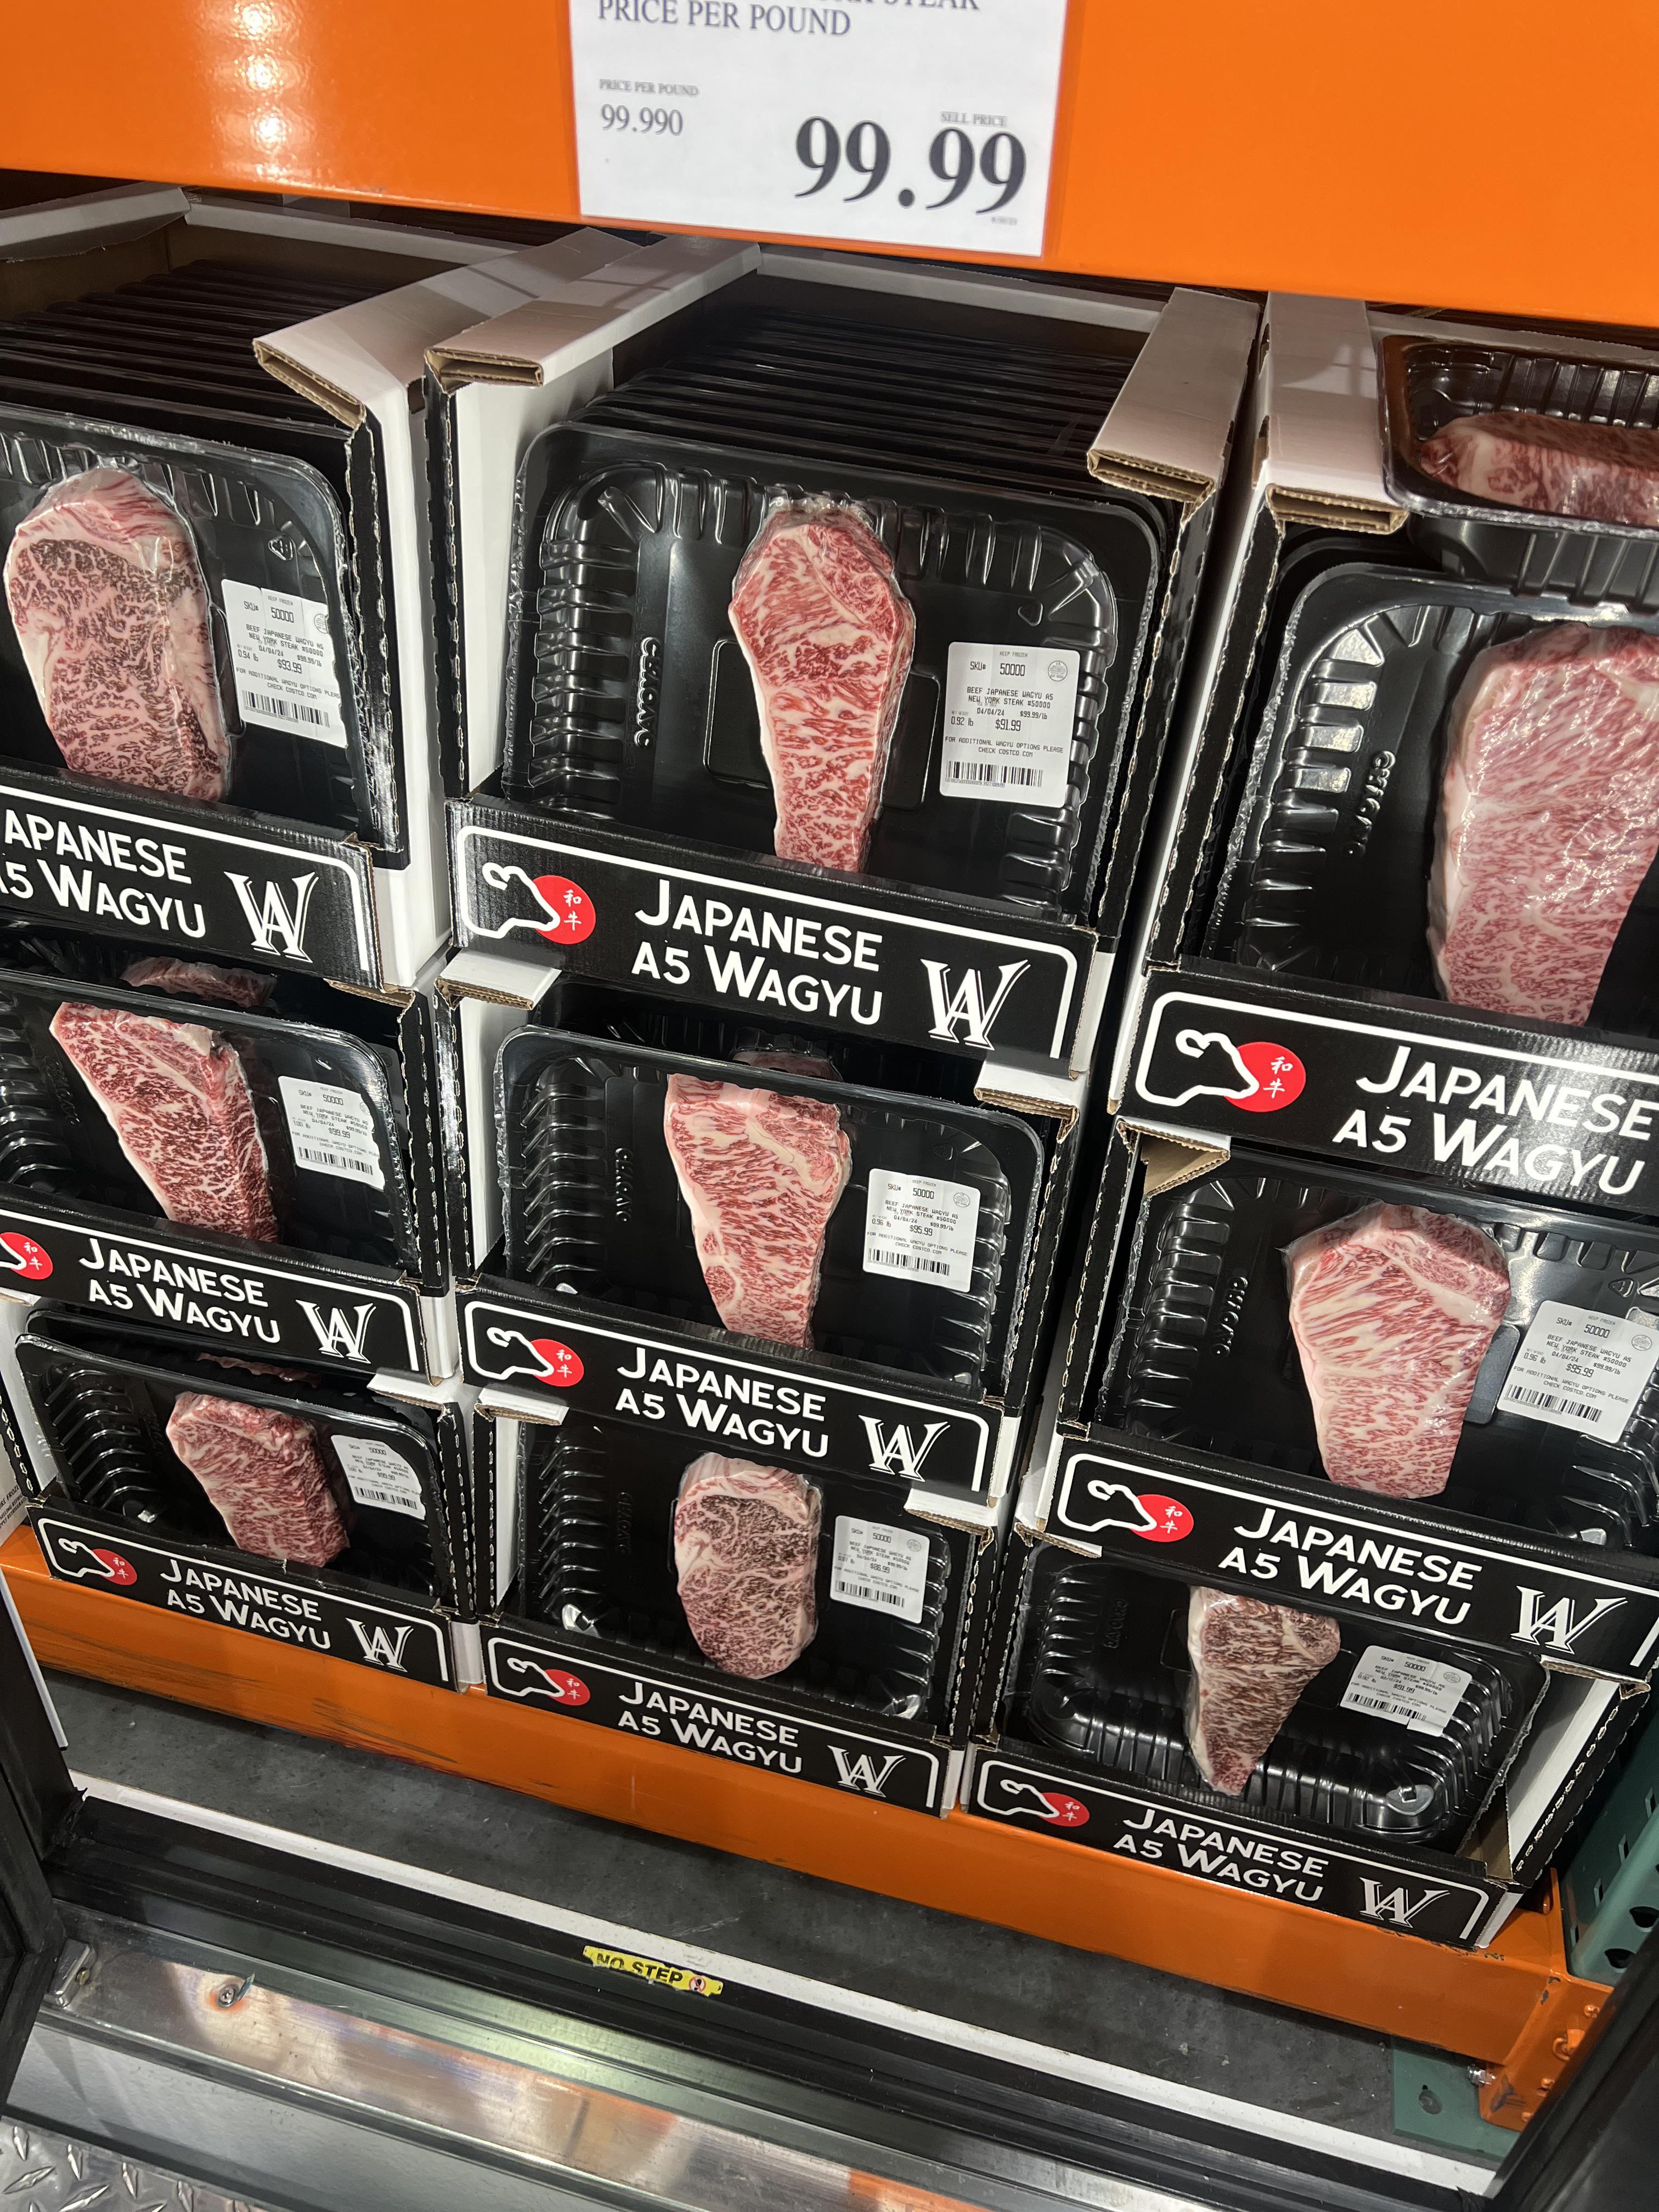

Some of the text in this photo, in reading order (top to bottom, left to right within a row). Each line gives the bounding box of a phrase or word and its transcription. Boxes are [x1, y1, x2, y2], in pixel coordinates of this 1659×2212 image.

[598, 0, 850, 36] PRICE PER POUND
[600, 79, 699, 97] PRICE PER POUND
[601, 104, 683, 136] 99.990
[941, 111, 1007, 127] SELL PRICE
[795, 116, 1026, 215] 99.99
[1000, 663, 1025, 676] 50000
[968, 695, 982, 704] NEW
[984, 696, 1000, 705] YORK
[1003, 697, 1023, 706] STEAK
[1027, 700, 1050, 709] #50000
[977, 707, 1004, 716] 04/04/24
[986, 688, 1018, 697] JAPANESE
[1022, 691, 1042, 699] WAGYU
[951, 716, 973, 726] 0.92 lb
[995, 718, 1021, 731] $91.99
[958, 737, 992, 746] ADDITIONAL
[1043, 745, 1063, 753] PLEASE
[37, 859, 205, 938] WAGYU
[563, 889, 582, 931] 和牛
[635, 879, 882, 971] JAPANESE
[631, 941, 882, 1024] A5 WAGYU
[1263, 1056, 1294, 1099] 和牛
[1356, 1046, 1659, 1141] JAPANESE
[323, 1094, 343, 1105] 50000
[1332, 1109, 1645, 1194] A5 WAGYU
[24, 1242, 43, 1271] 和牛
[80, 1238, 268, 1307] JAPANESE
[89, 1279, 280, 1342] A5 WAGYU
[556, 1348, 572, 1378] 和牛
[617, 1347, 826, 1421] JAPANESE
[616, 1389, 828, 1457] A5 WAGYU
[1160, 1505, 1183, 1534] 和牛
[112, 1557, 128, 1579] 和牛
[1234, 1508, 1482, 1590] JAPANESE
[160, 1559, 321, 1621] JAPANESE
[1218, 1547, 1470, 1624] A5 WAGYU
[168, 1589, 330, 1649] A5 WAGYU
[1404, 1661, 1426, 1672] 50000
[566, 1678, 580, 1699] 和牛
[619, 1682, 798, 1747] JAPANESE
[618, 1711, 802, 1773] A5 WAGYU
[1063, 1802, 1080, 1821] 和牛
[1123, 1809, 1328, 1877] JAPANESE
[1114, 1835, 1323, 1900] A5 WAGYU
[596, 1953, 683, 1984] NO STEP
